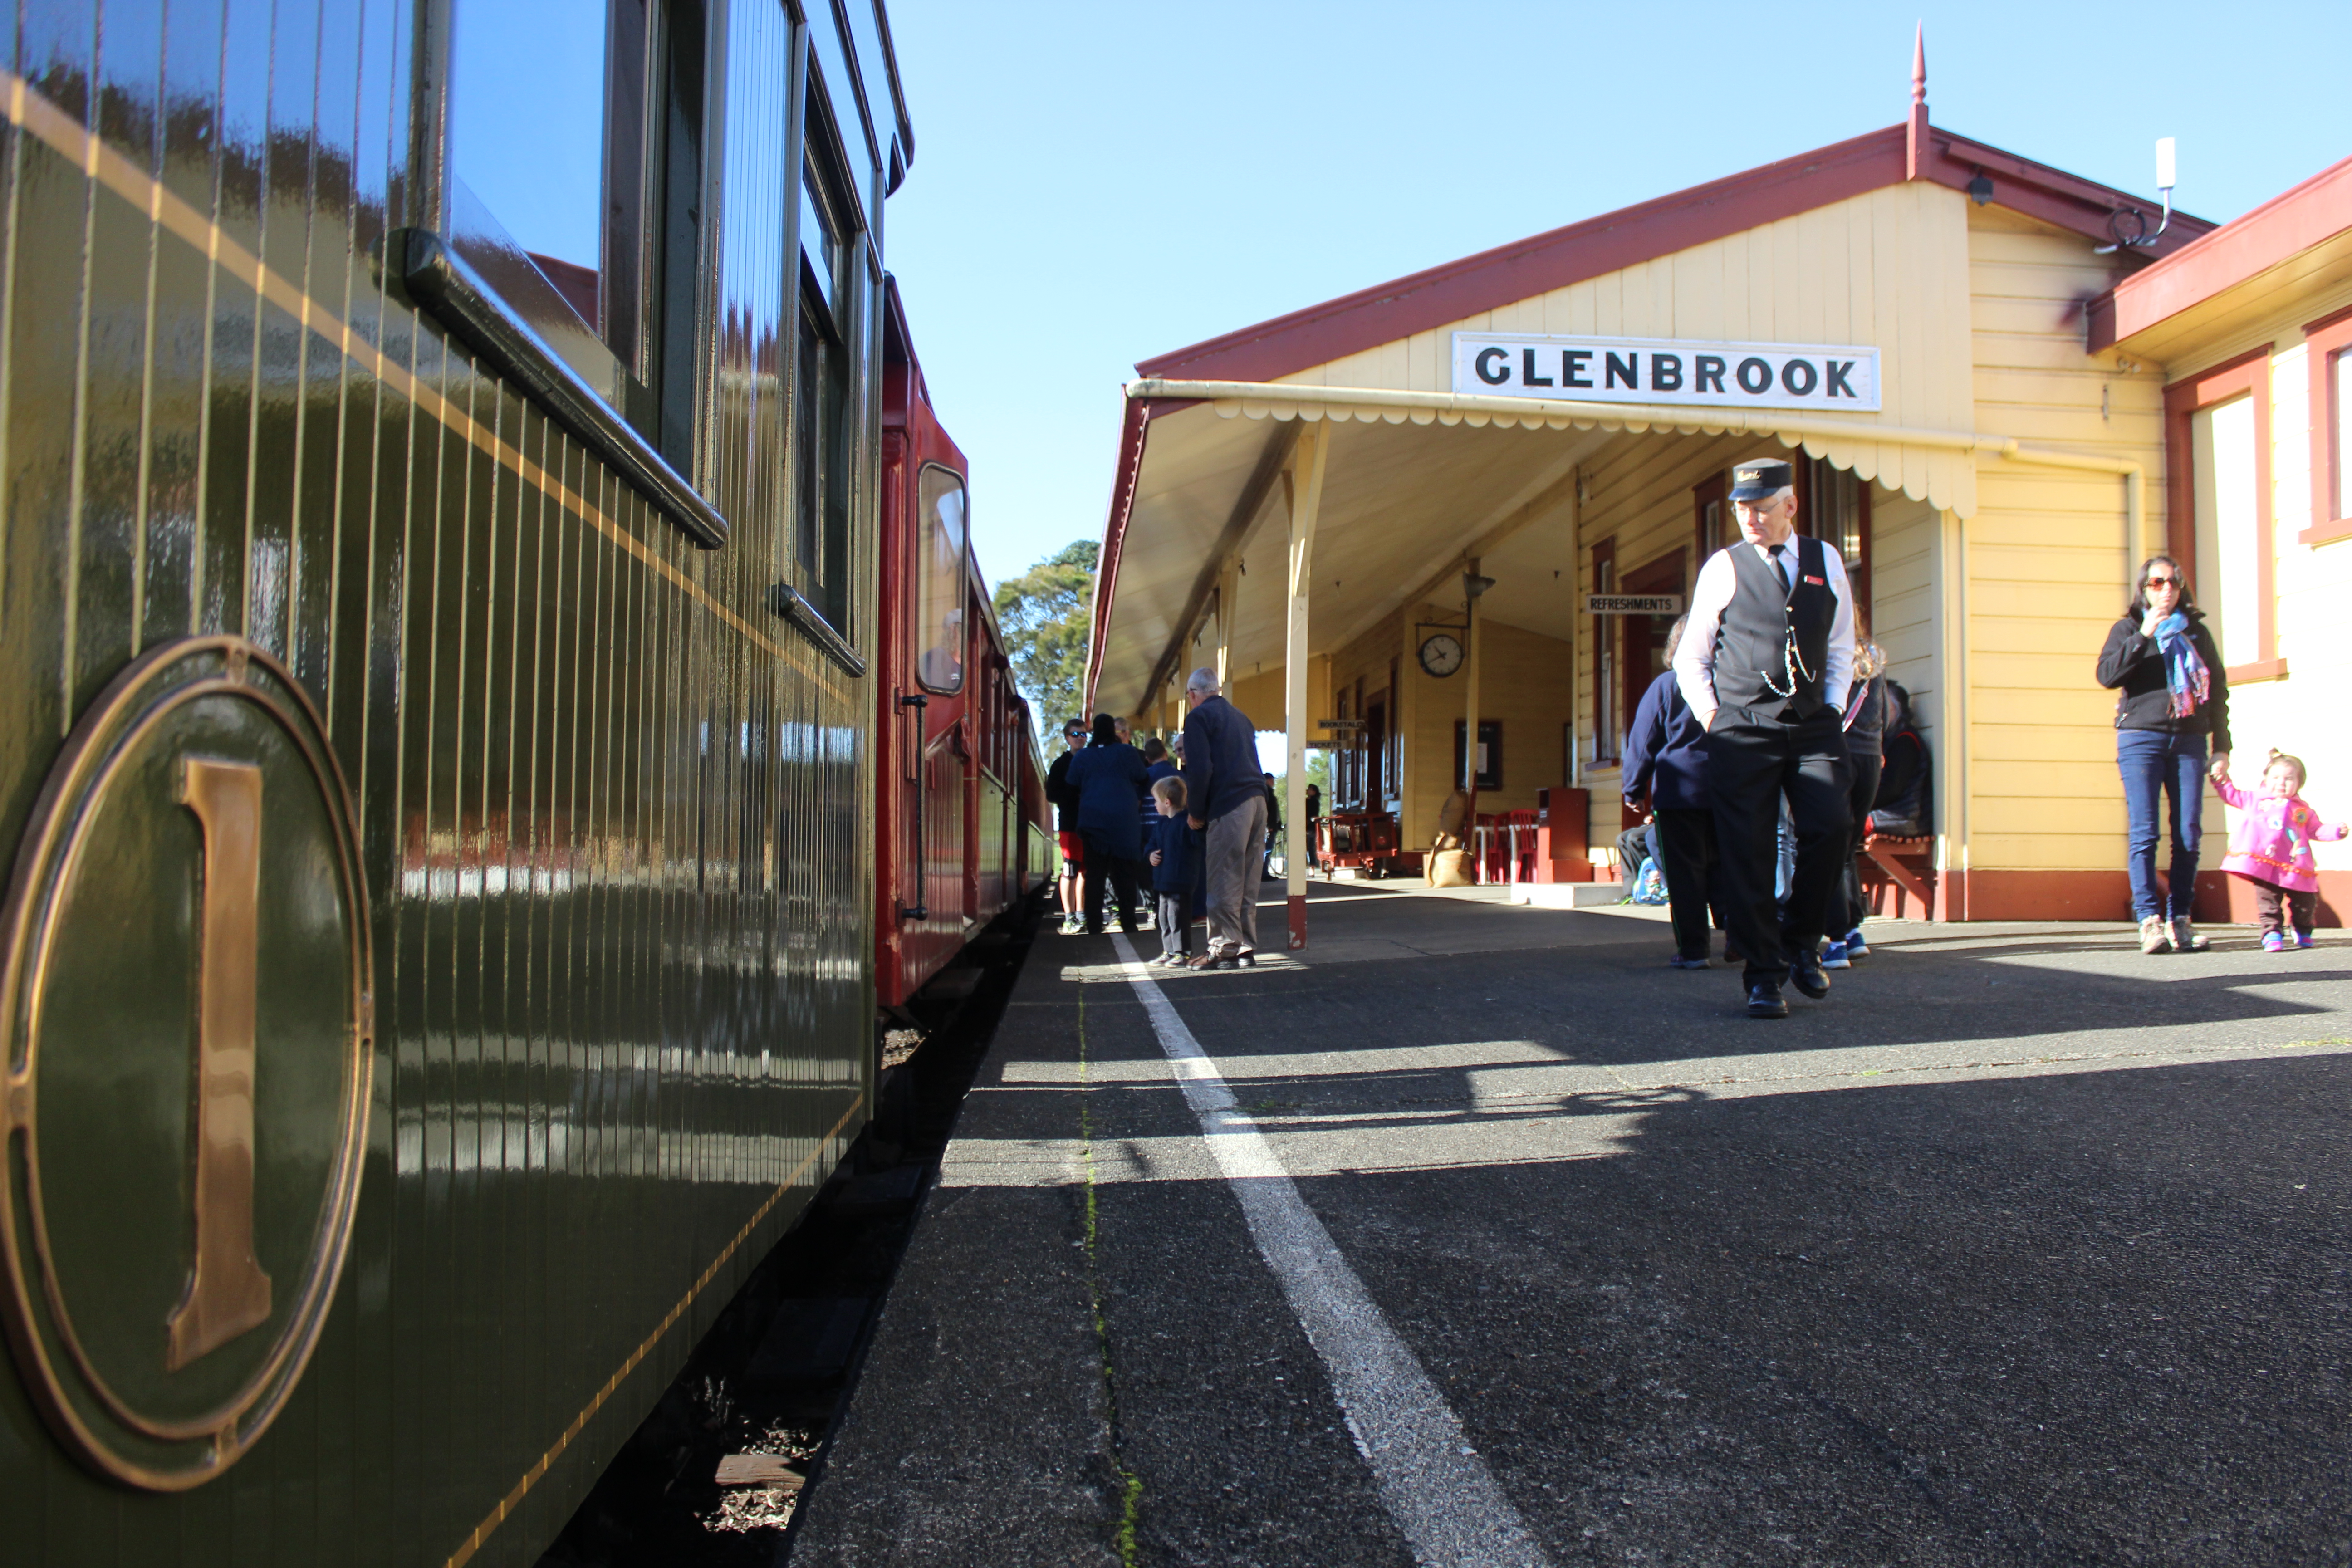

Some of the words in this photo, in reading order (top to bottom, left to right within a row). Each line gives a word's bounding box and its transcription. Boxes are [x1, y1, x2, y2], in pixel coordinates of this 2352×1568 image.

[1475, 348, 1857, 397] GLENBROOK
[1591, 598, 1672, 610] REFRESHMENTS
[168, 754, 272, 1373] 1
